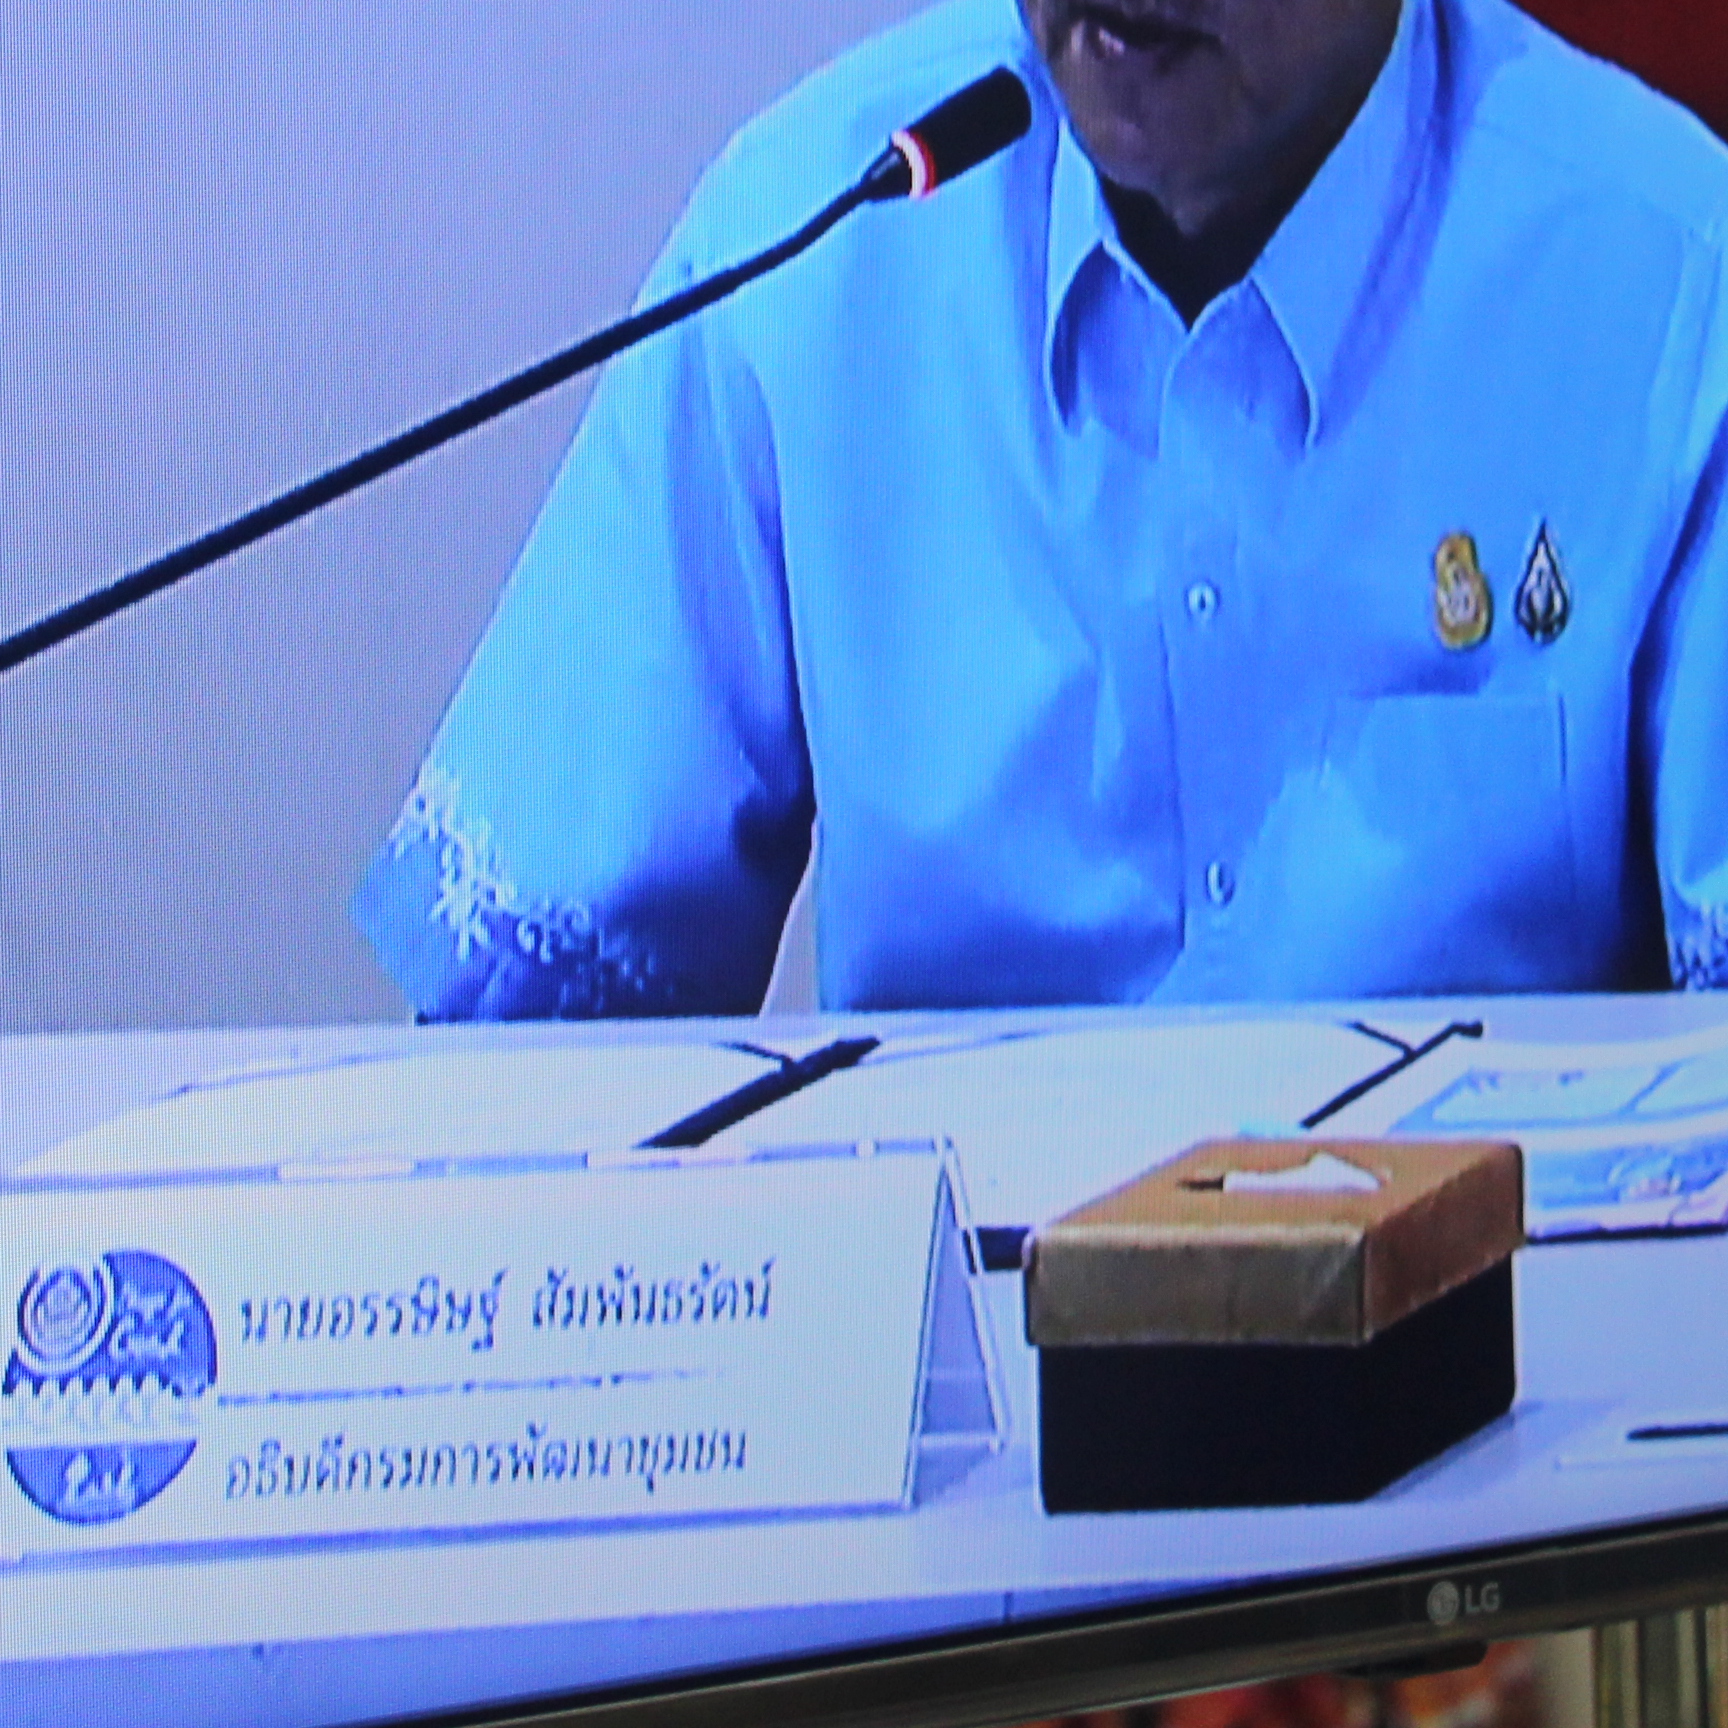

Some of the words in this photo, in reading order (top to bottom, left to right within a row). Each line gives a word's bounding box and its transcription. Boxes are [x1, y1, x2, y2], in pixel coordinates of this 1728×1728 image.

[531, 1255, 775, 1329] สัมพันธรัตน์
[225, 1422, 747, 1500] อธิบดีกรมการพัฒนาชุมชน
[1464, 1582, 1500, 1613] LG
